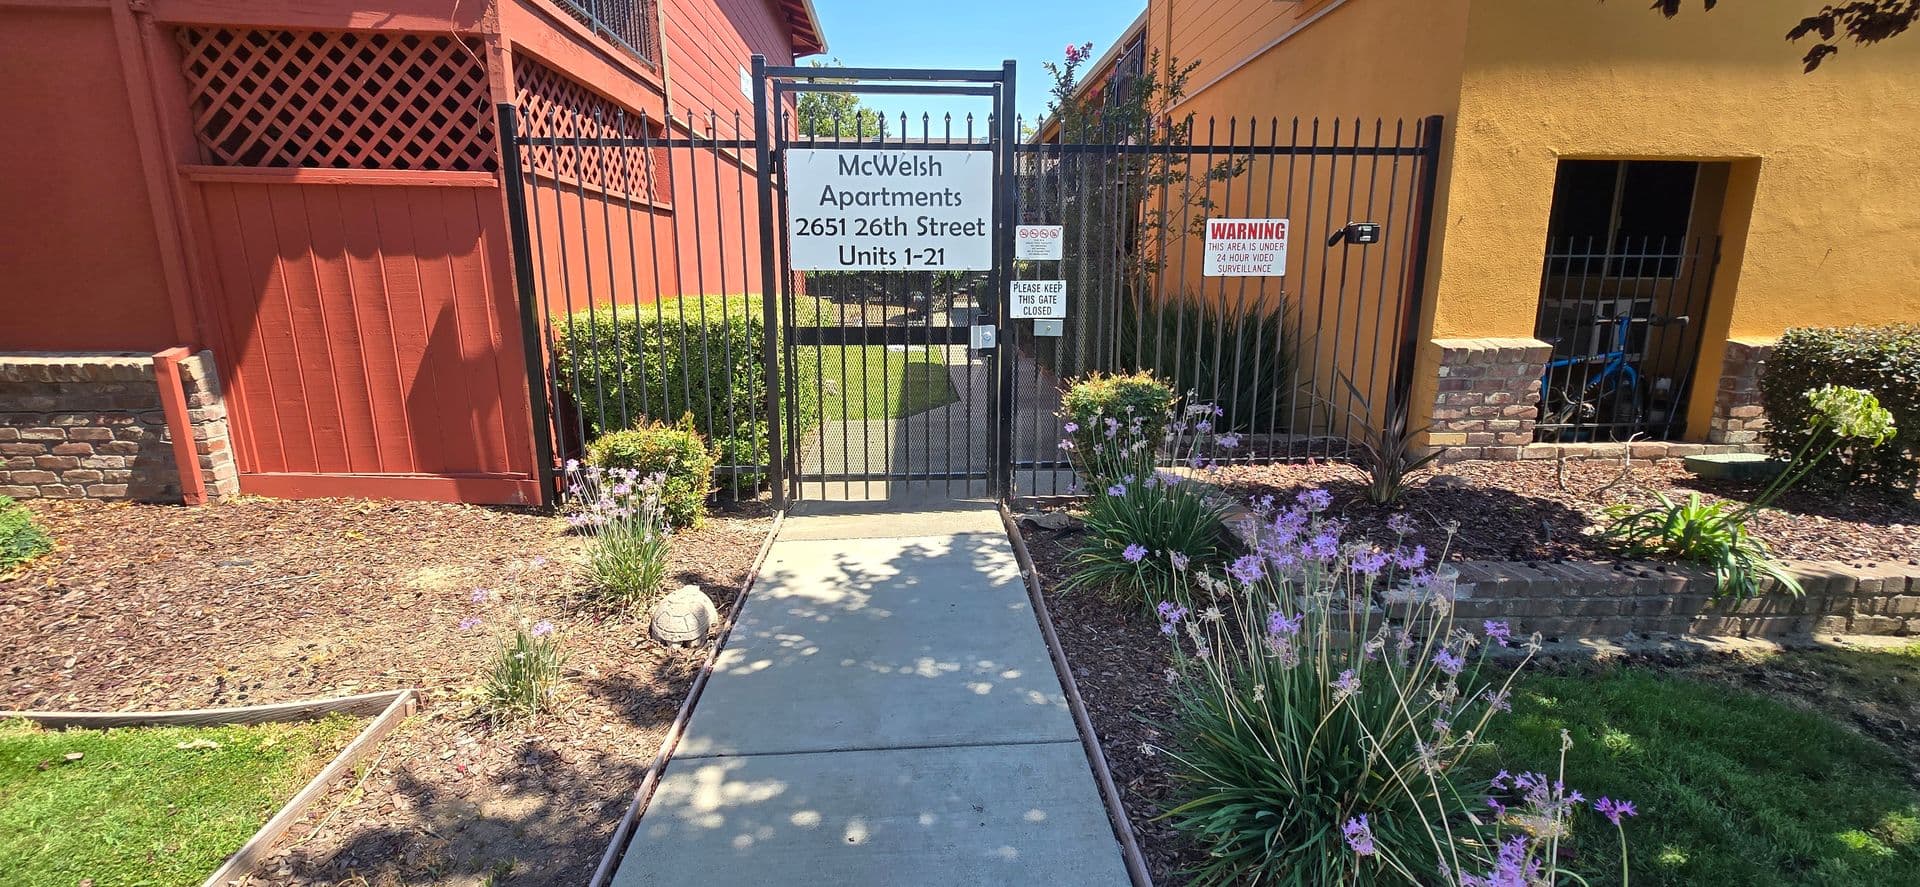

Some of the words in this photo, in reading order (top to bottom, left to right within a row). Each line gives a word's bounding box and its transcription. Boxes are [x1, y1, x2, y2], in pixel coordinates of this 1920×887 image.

[838, 154, 942, 176] McWelsh
[819, 184, 962, 210] Apartments
[795, 218, 846, 237] 2651
[854, 216, 907, 237] 26th
[917, 216, 986, 237] Street
[1211, 223, 1285, 240] WARNING
[1209, 242, 1224, 251] THIS
[1227, 243, 1246, 251] AREA
[1249, 243, 1256, 251] IS
[1259, 243, 1284, 251] UNDER
[839, 245, 896, 266] Units
[904, 248, 945, 266] 1-21
[1216, 253, 1226, 262] 24
[1229, 253, 1249, 262] HOUR
[1252, 253, 1274, 262] VIDEO
[1217, 264, 1272, 273] SURVEILLANCE
[1013, 283, 1041, 293] PLEASE
[1044, 283, 1063, 293] KEEP
[1018, 295, 1035, 305] THIS
[1038, 295, 1057, 305] GATE
[1023, 306, 1052, 316] CLOSED
